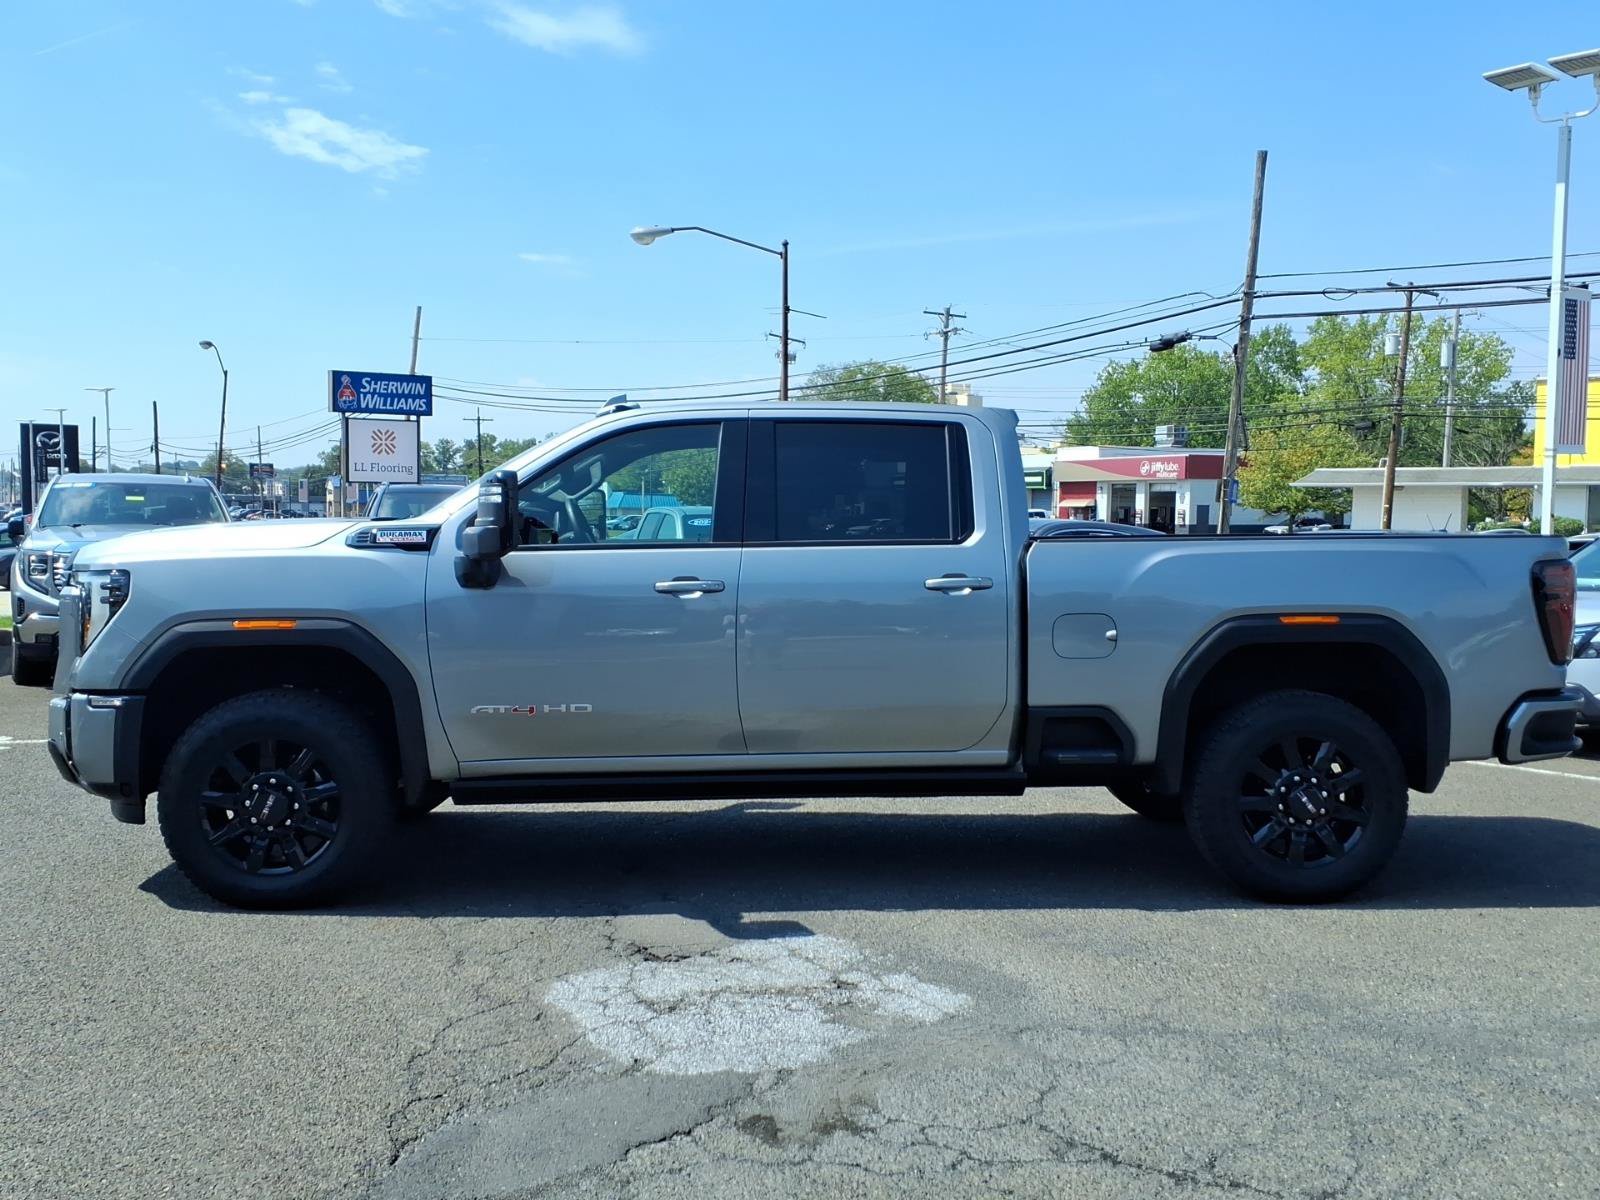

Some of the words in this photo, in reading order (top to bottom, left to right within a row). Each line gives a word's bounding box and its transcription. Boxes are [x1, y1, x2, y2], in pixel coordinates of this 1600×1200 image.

[360, 378, 426, 395] SHERWIN
[360, 394, 427, 411] WILLIAMS
[354, 462, 367, 472] LL
[370, 462, 413, 475] Flooring
[470, 704, 537, 716] AT4
[543, 703, 593, 713] HD
